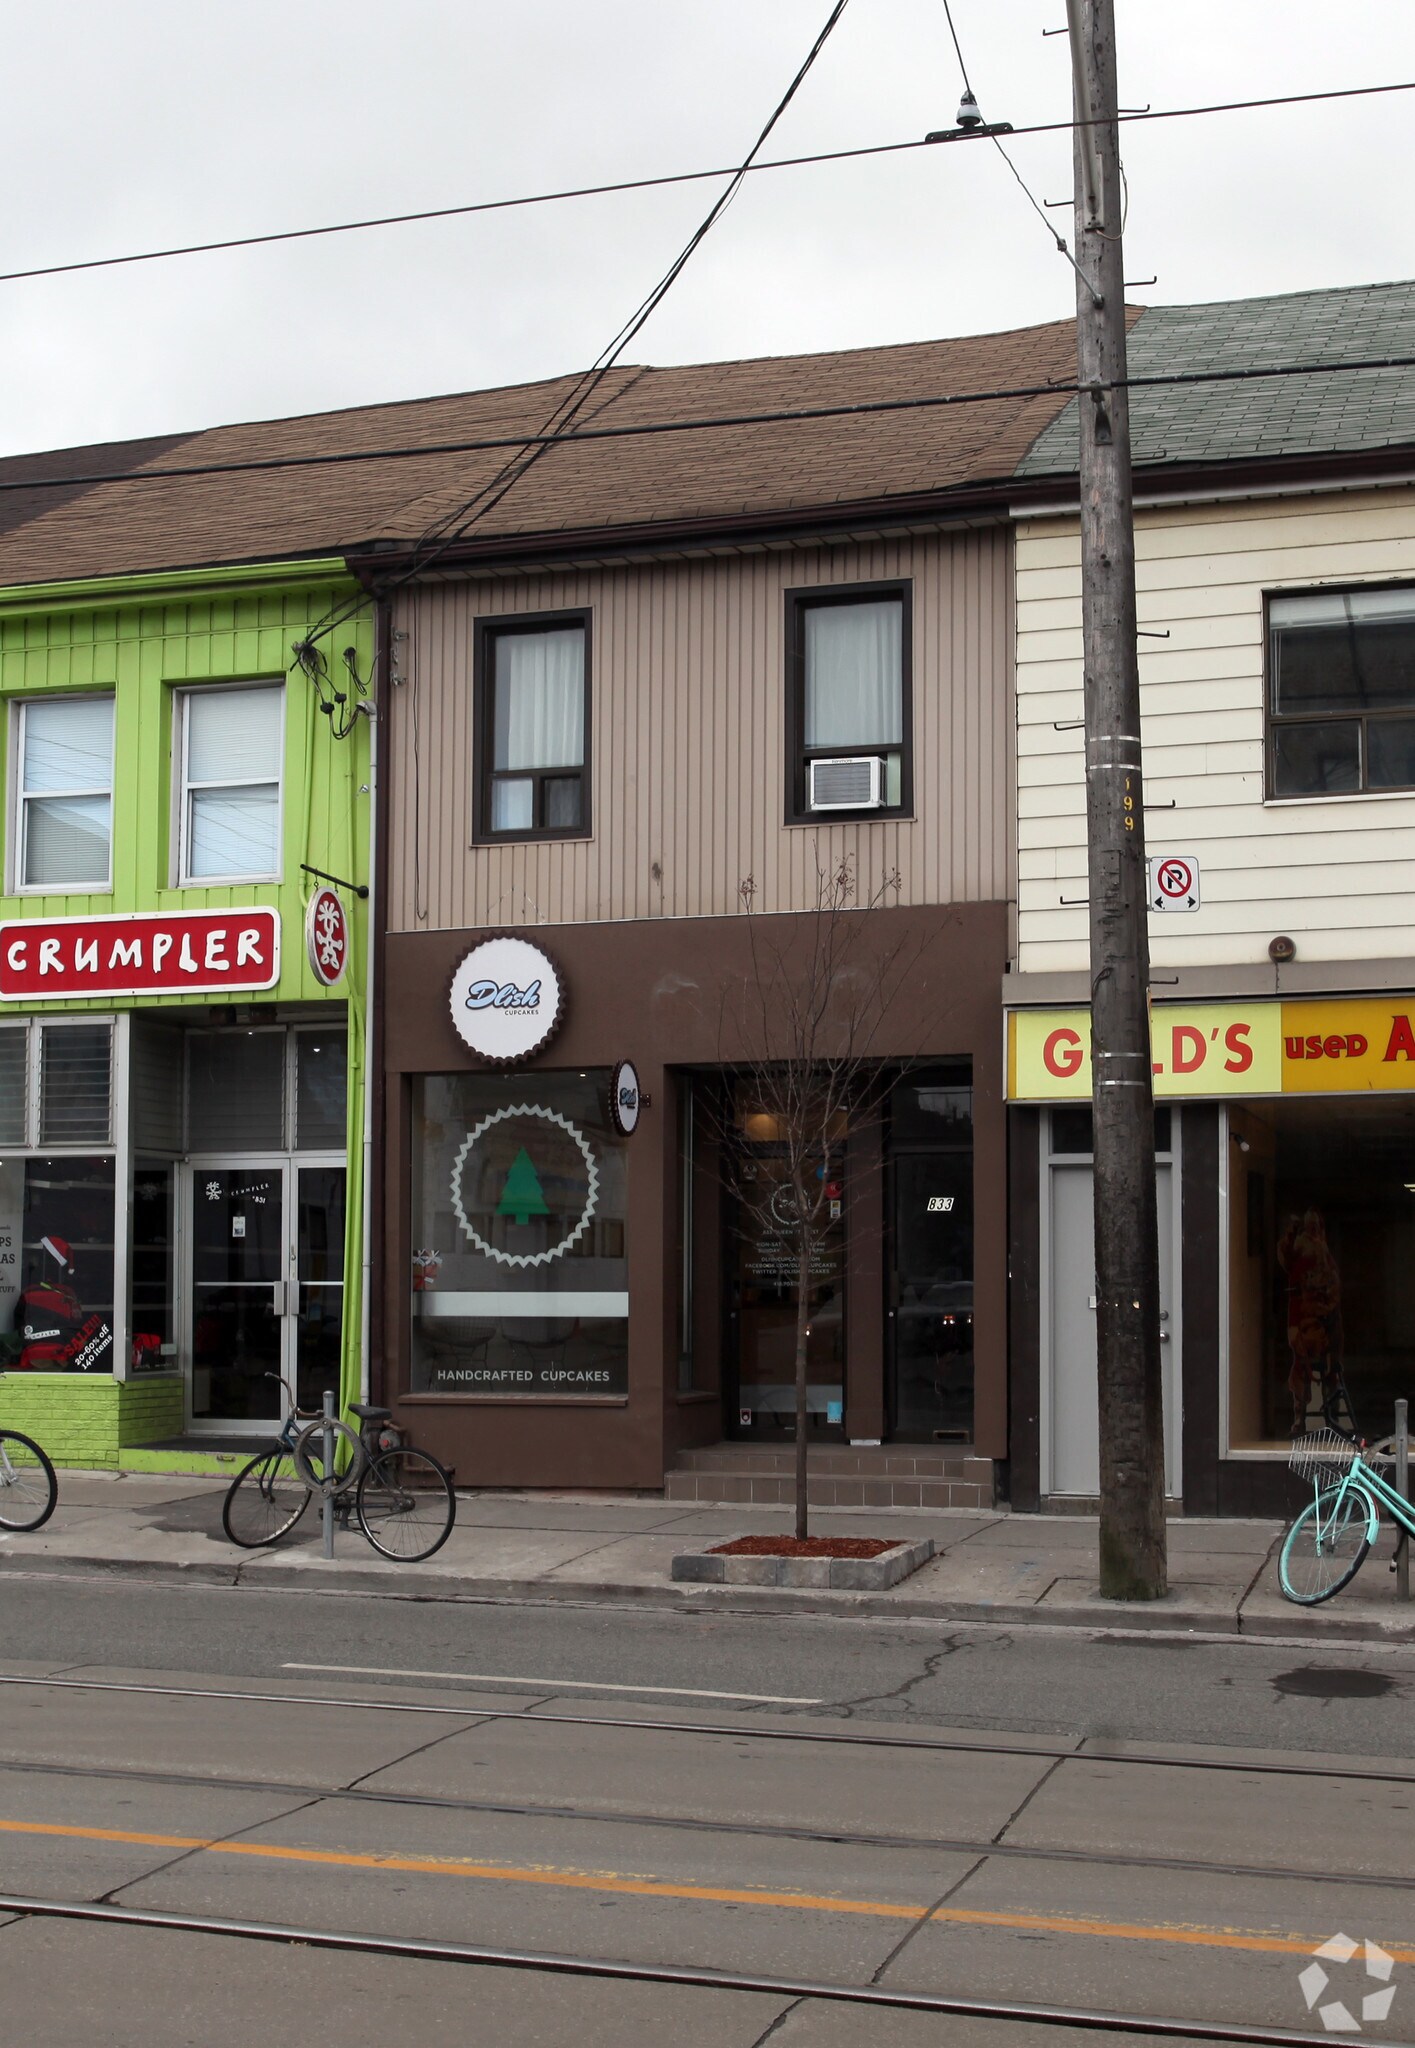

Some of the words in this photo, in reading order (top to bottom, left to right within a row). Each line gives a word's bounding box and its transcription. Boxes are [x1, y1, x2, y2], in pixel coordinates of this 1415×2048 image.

[7, 929, 264, 975] CRUMPLER
[465, 979, 541, 1011] Dlish
[1043, 1022, 1254, 1078] GD'S
[928, 1198, 953, 1211] 833
[74, 1336, 100, 1366] 20-60%
[98, 1323, 110, 1339] off
[81, 1354, 95, 1370] 140
[92, 1334, 113, 1357] items
[437, 1369, 534, 1381] HANDCRAFTED
[540, 1370, 611, 1382] CUPCAKES
